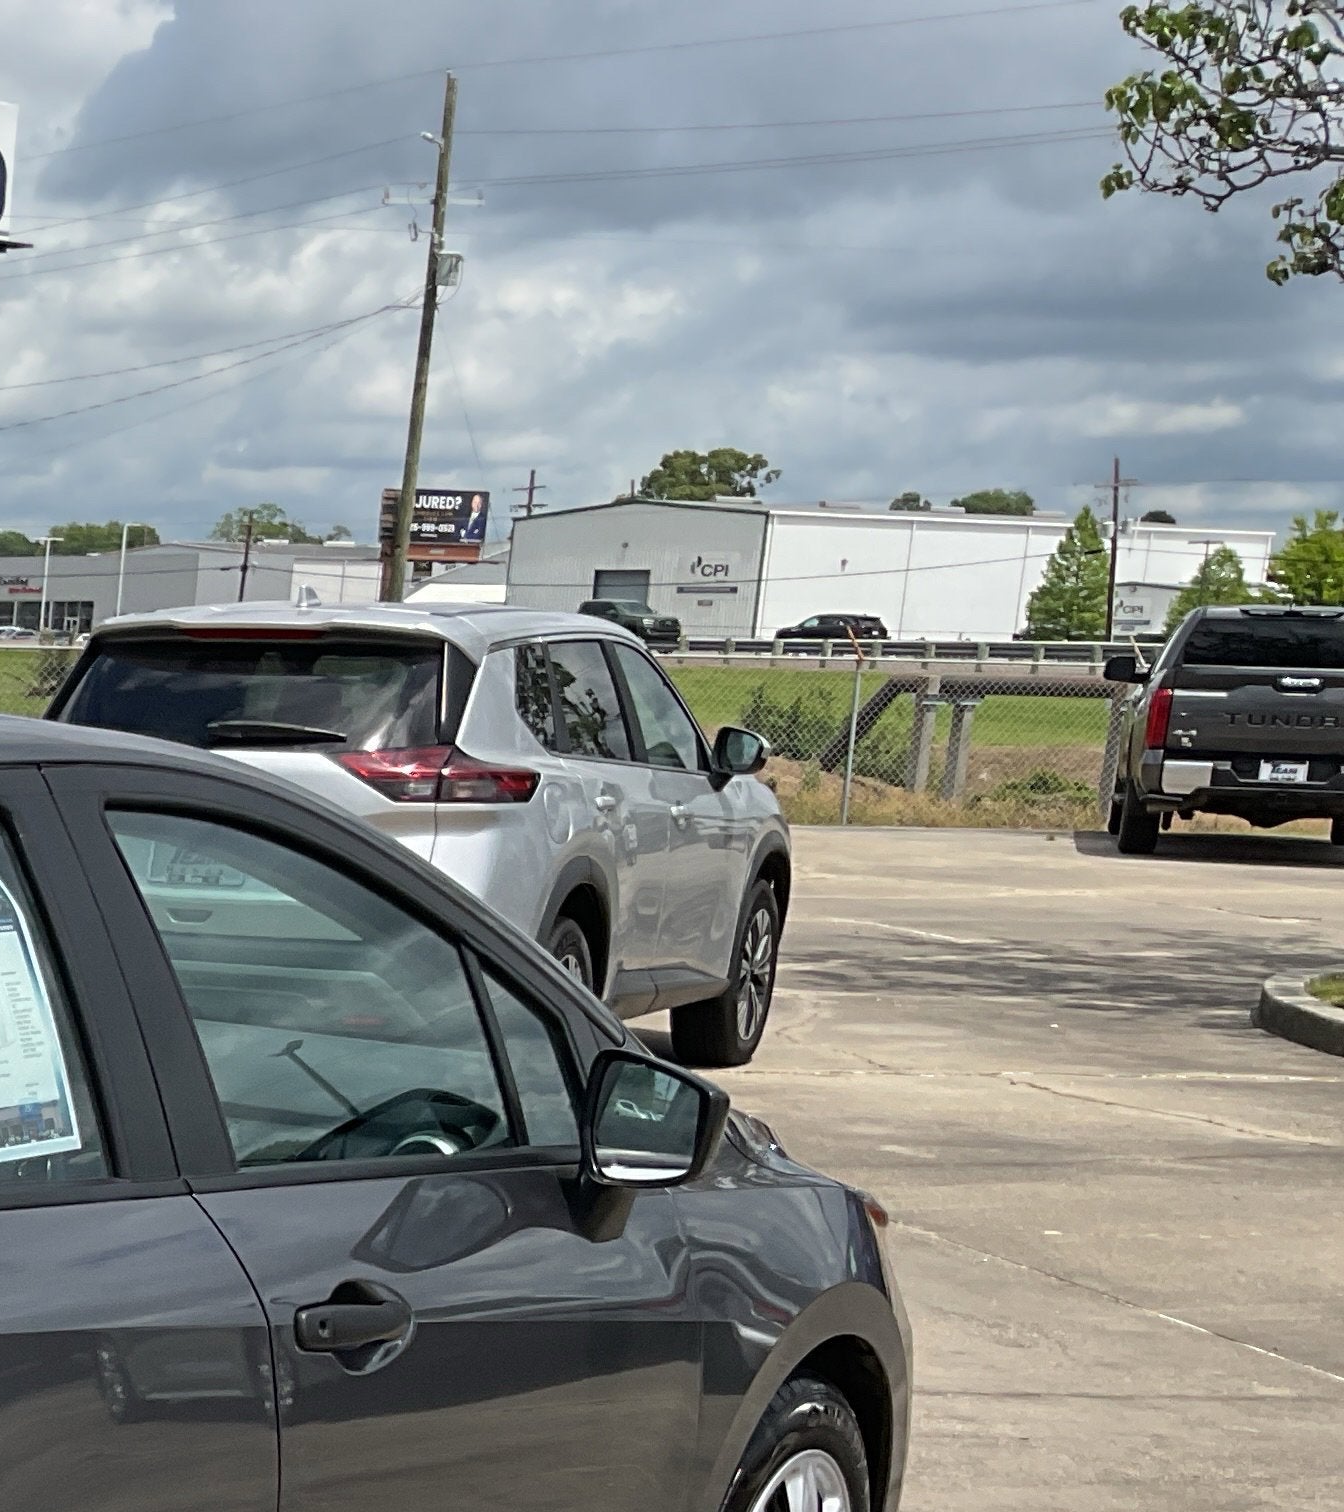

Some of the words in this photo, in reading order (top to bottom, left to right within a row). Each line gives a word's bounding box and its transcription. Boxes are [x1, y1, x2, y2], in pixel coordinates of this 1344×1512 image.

[415, 495, 462, 510] JURED?
[701, 564, 729, 577] CPI
[1224, 711, 1344, 729] TUNDR
